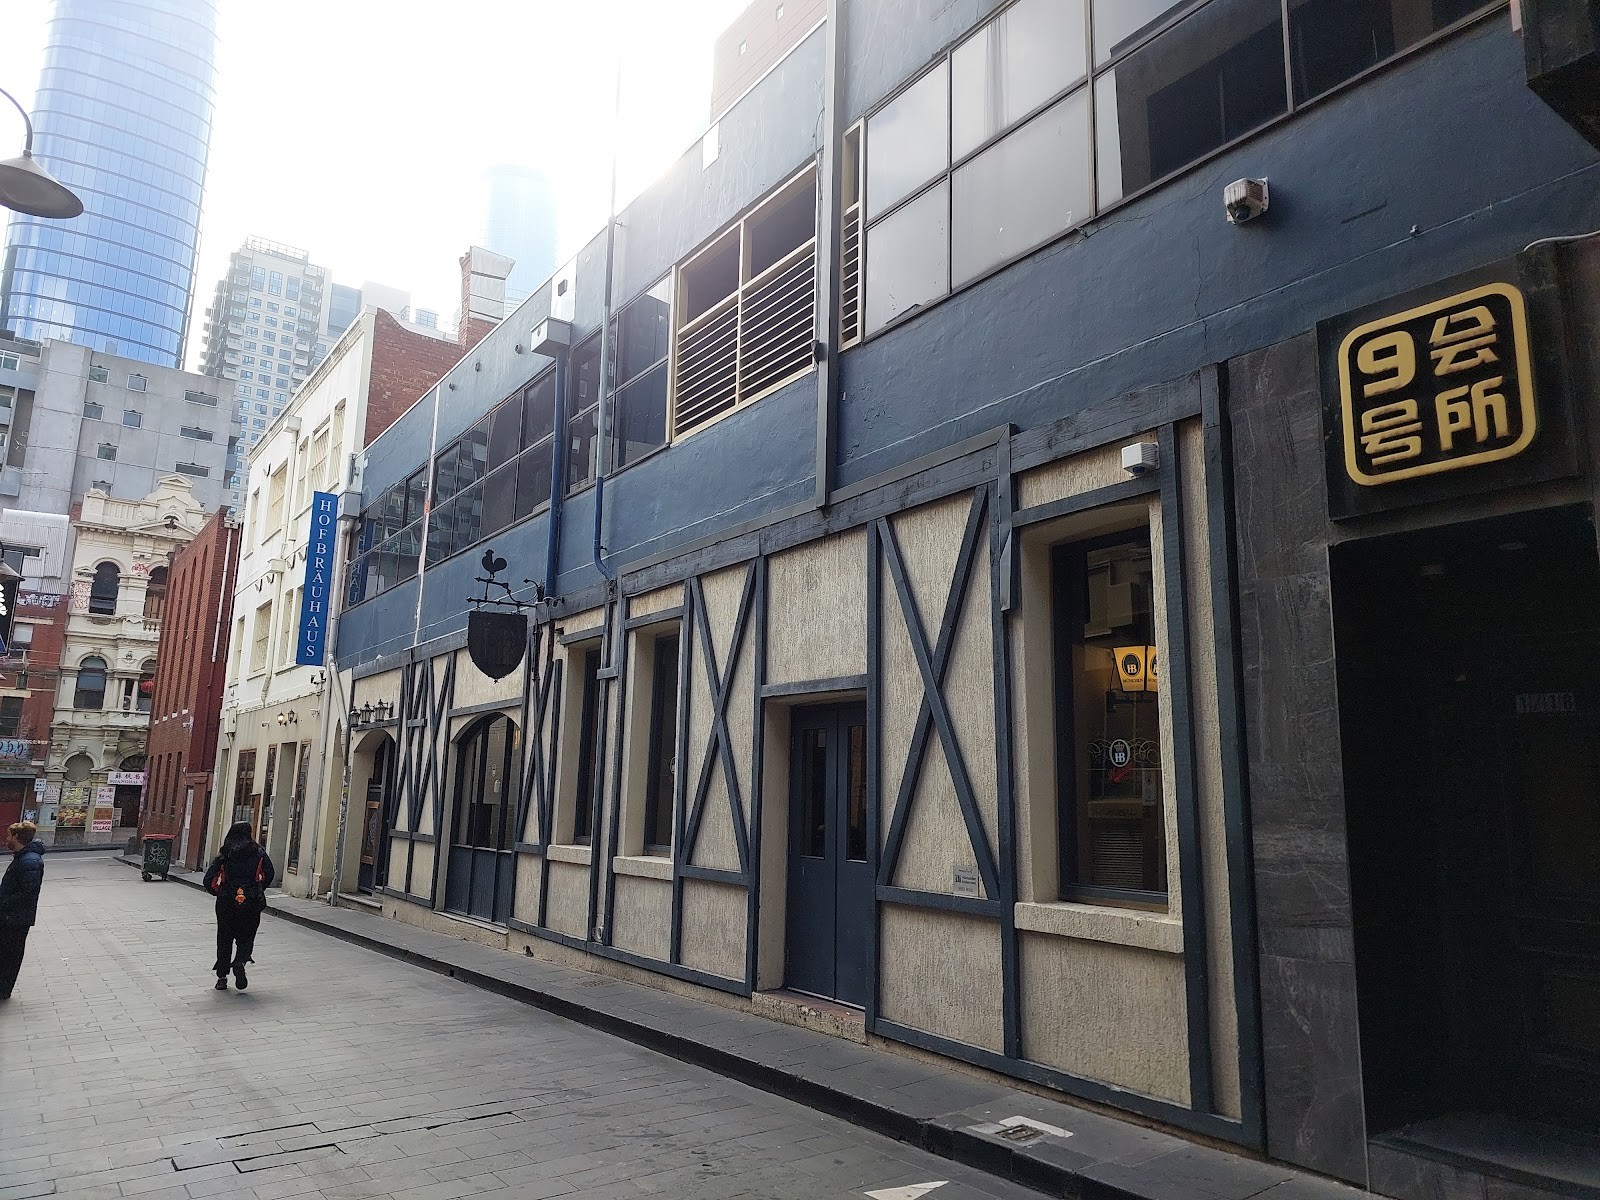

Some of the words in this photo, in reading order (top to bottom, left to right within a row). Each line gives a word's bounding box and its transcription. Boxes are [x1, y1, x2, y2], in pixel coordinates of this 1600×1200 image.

[306, 500, 331, 657] HOFBRÄUHAUS
[1127, 664, 1137, 674] HB
[1114, 752, 1126, 763] HB
